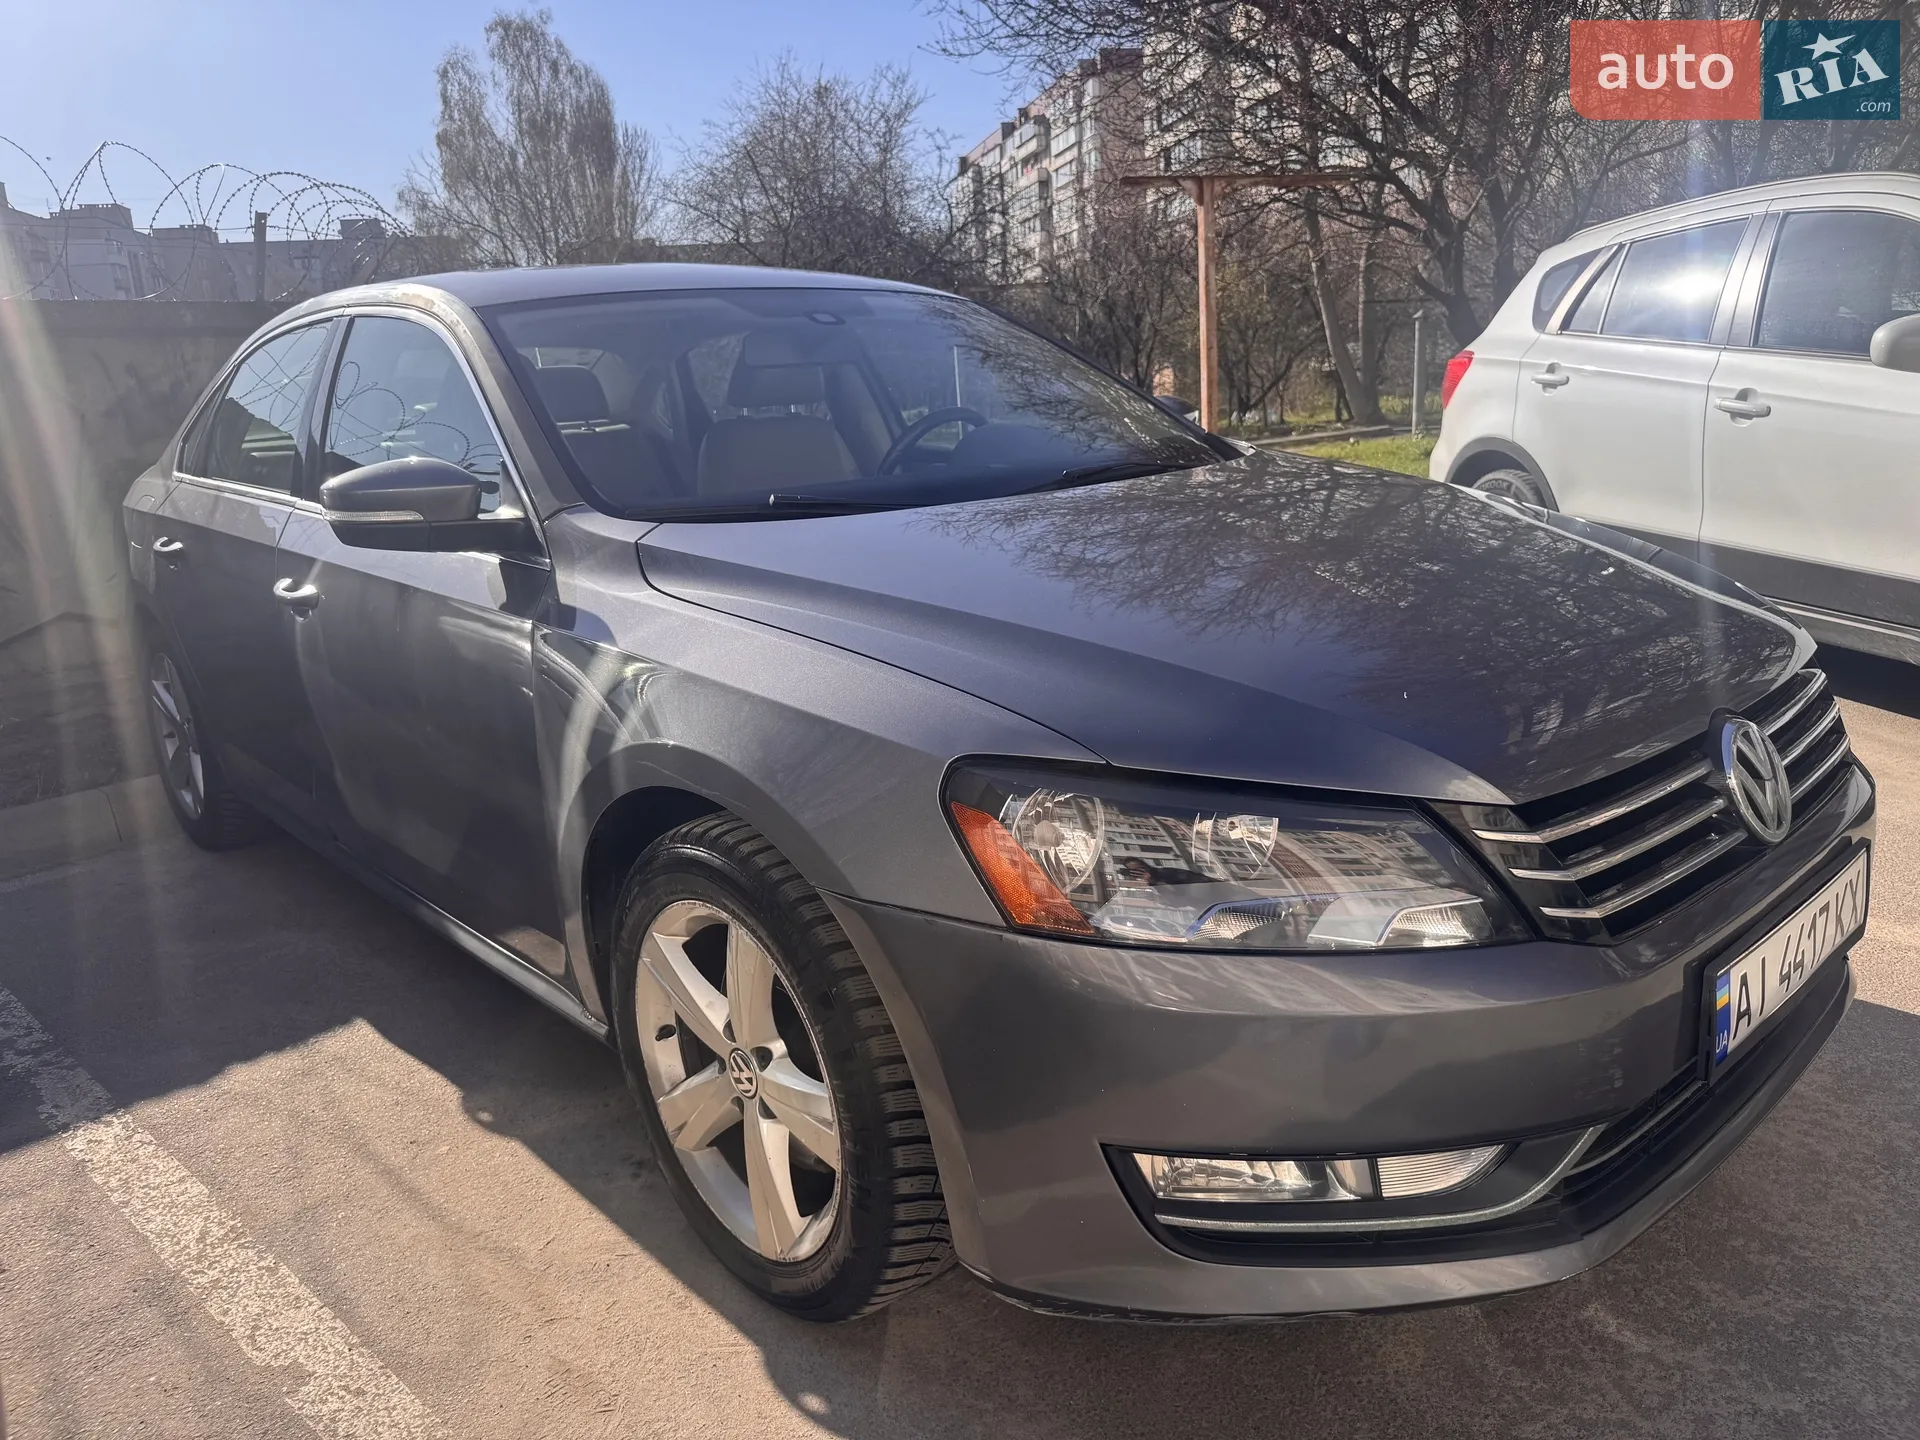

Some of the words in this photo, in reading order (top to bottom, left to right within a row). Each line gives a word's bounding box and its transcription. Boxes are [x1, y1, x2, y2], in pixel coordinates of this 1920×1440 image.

[1732, 955, 1767, 1041] AI
[1778, 900, 1831, 993] 4417
[1832, 869, 1861, 948] KX
[1715, 1029, 1728, 1054] UA
